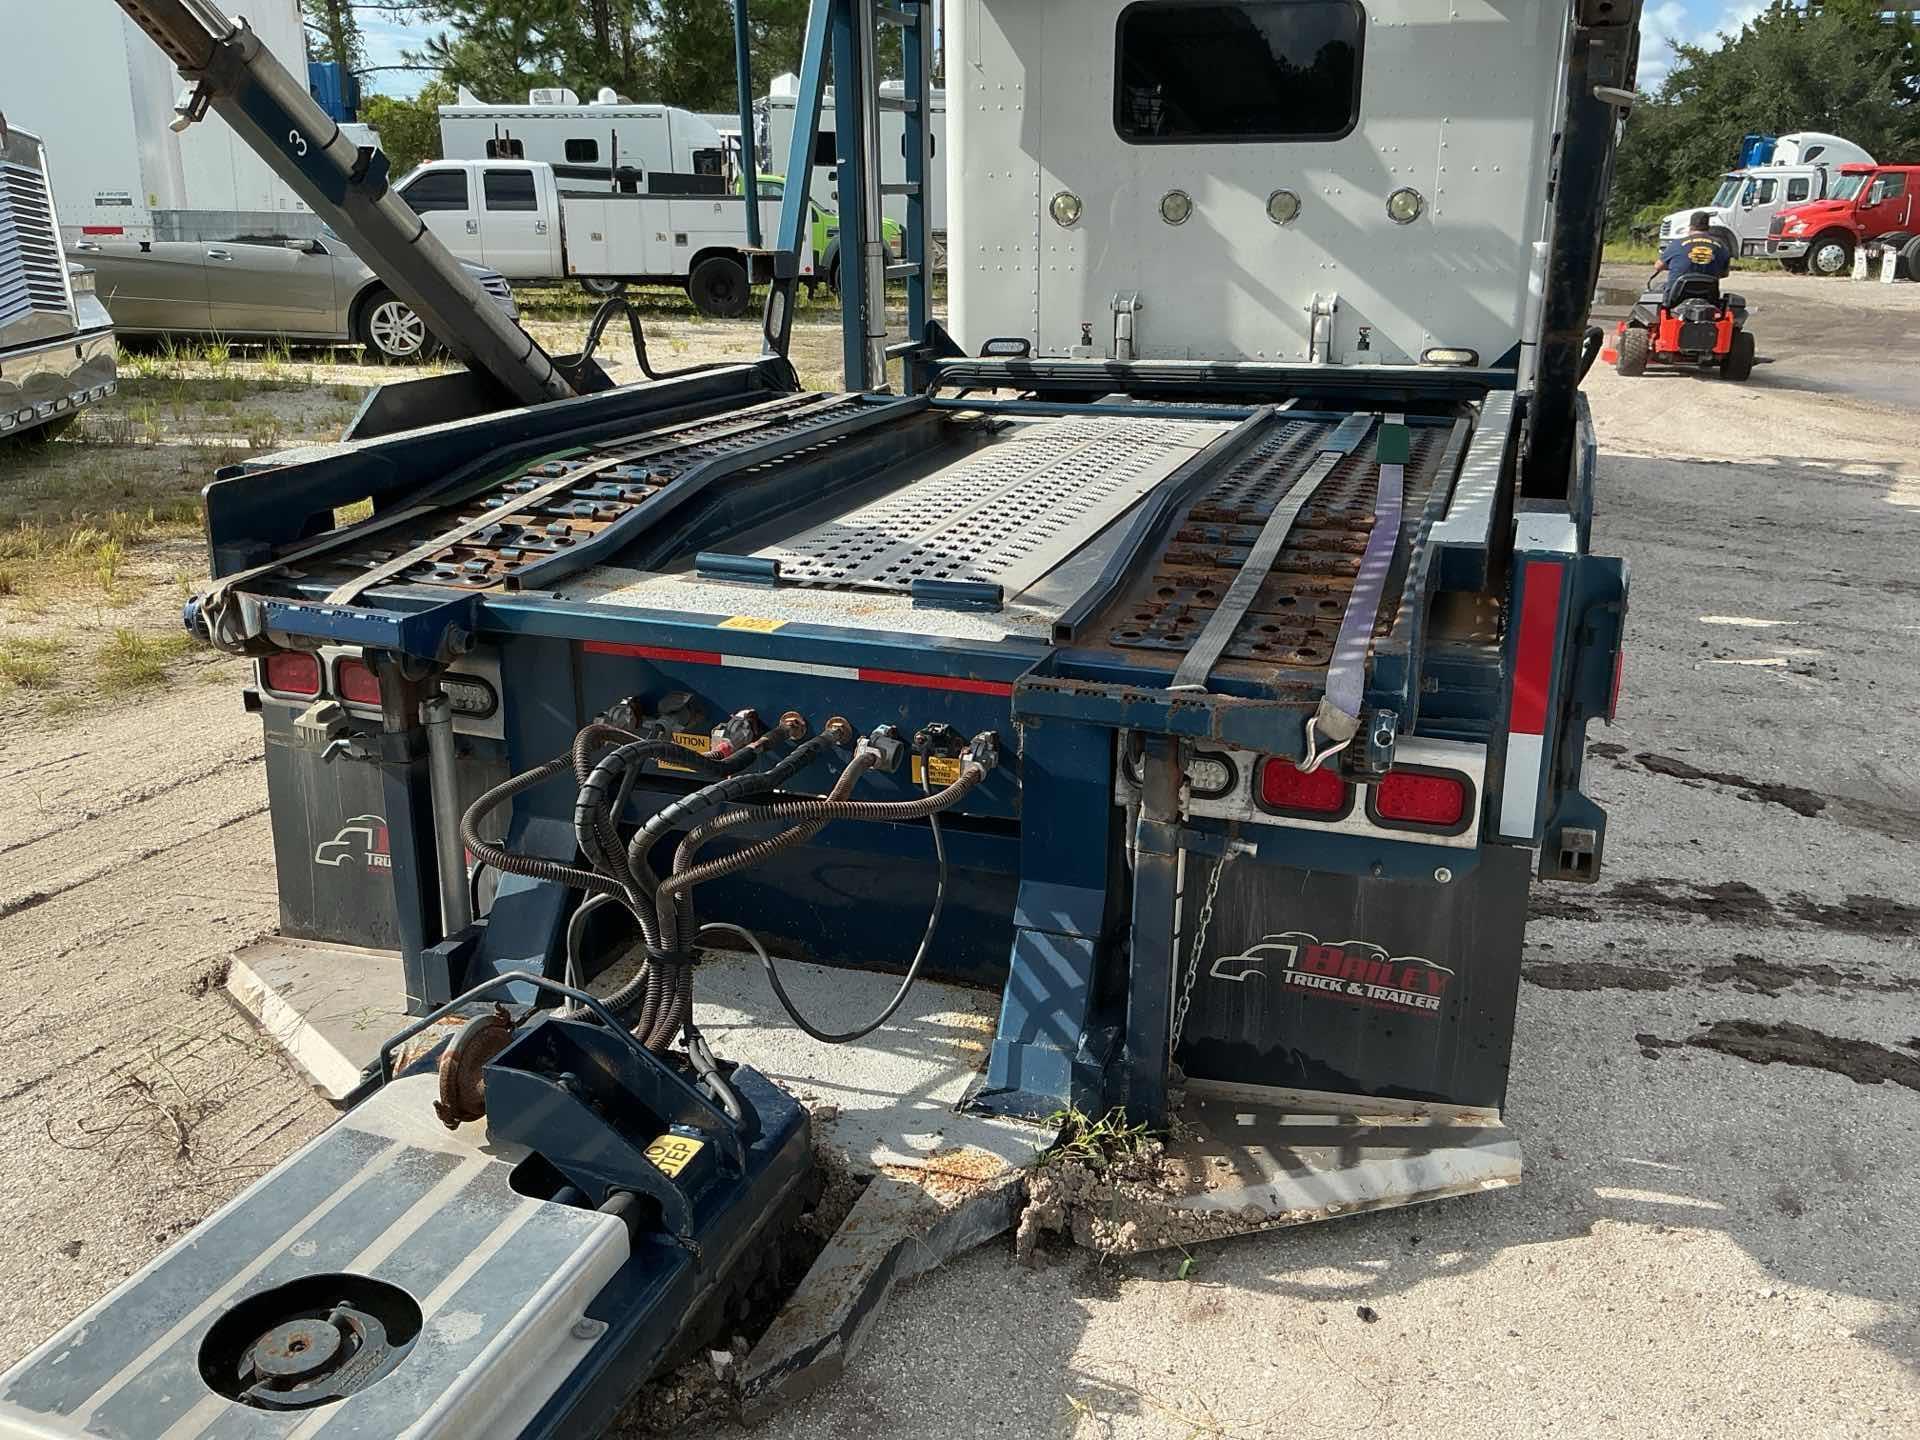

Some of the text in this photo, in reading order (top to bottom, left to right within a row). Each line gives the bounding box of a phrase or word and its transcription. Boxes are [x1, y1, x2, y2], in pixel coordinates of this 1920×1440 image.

[288, 129, 307, 156] 3
[671, 735, 705, 747] AUTION
[364, 852, 391, 867] TRU
[1303, 944, 1449, 993] BAILEY
[1282, 970, 1346, 993] TRUCK
[1347, 981, 1364, 997] &
[1364, 982, 1440, 1010] TRAILER
[645, 1146, 666, 1160] O
